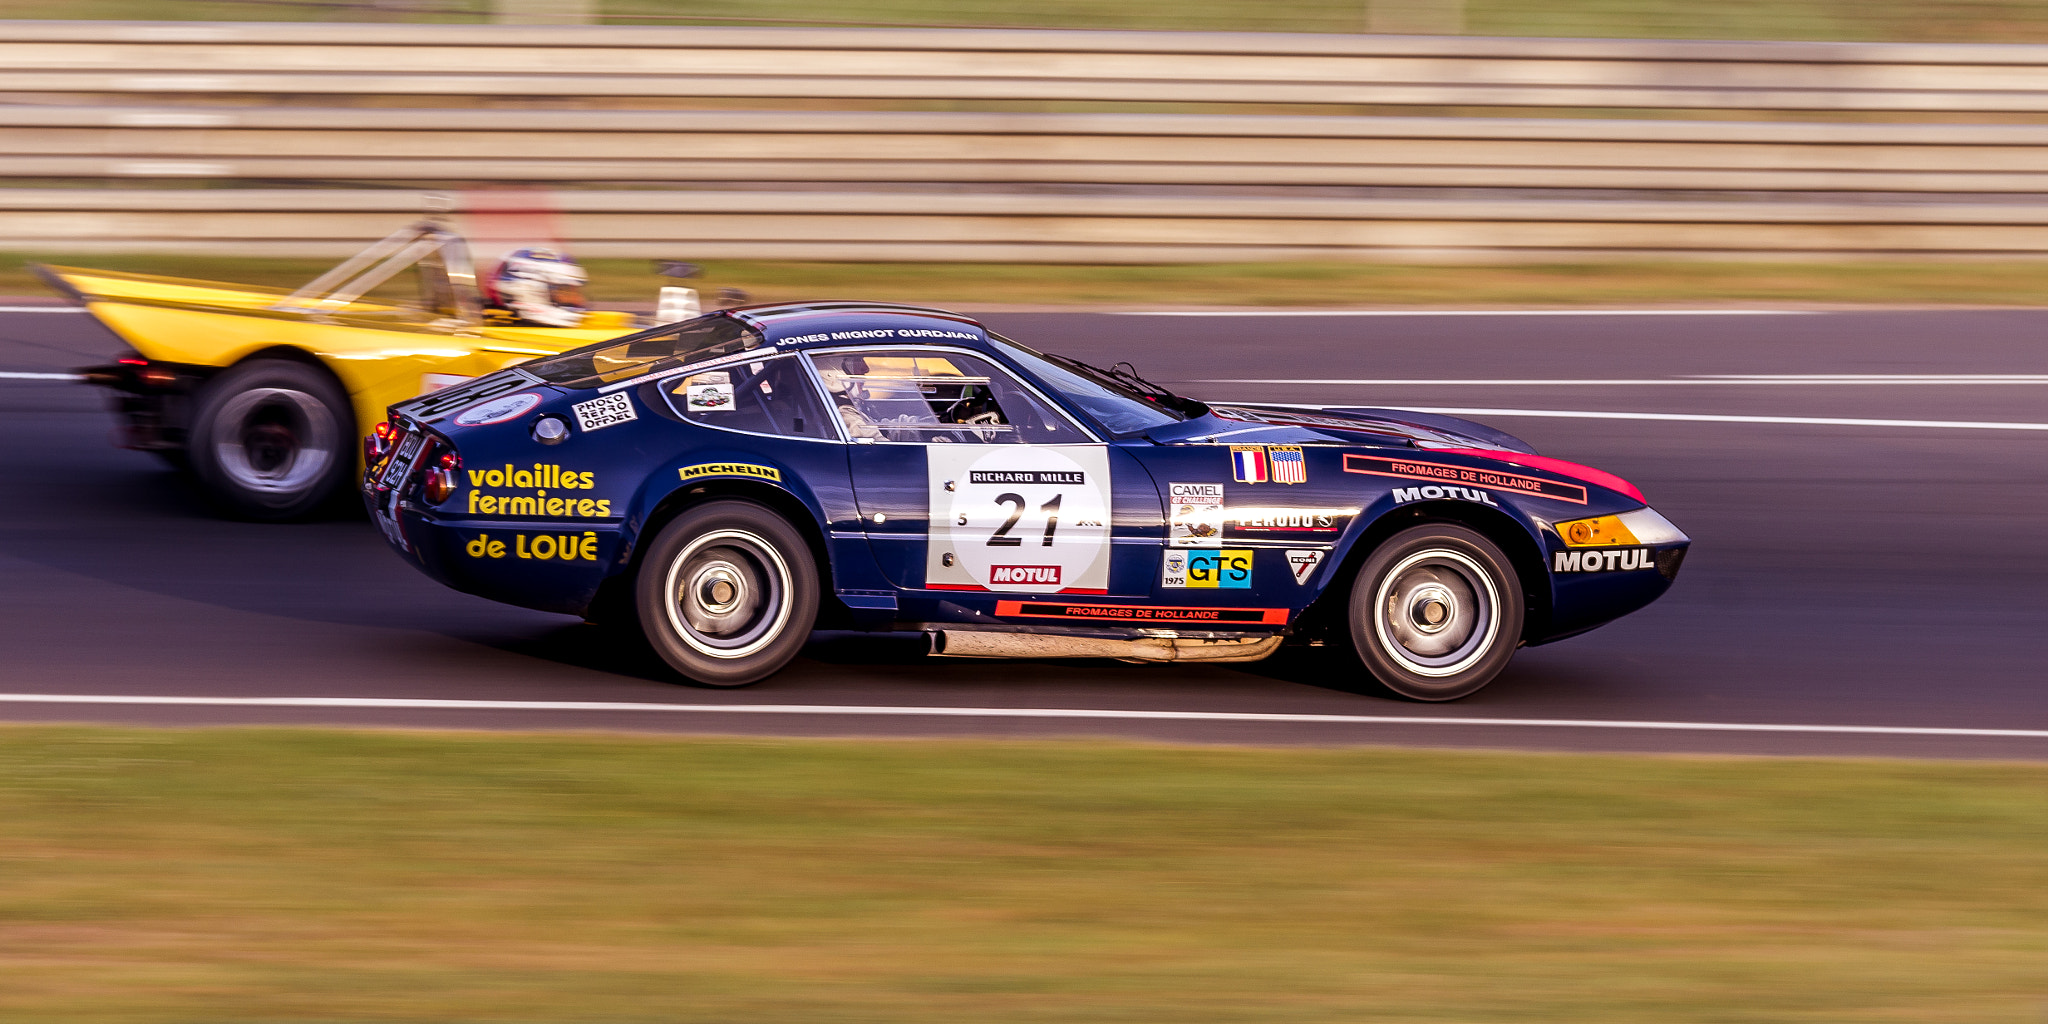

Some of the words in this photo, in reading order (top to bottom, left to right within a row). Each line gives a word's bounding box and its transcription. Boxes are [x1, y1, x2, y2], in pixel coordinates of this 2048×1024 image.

[776, 332, 830, 347] JONES
[831, 329, 895, 341] MIGNOT
[897, 329, 979, 341] GURDJIAN
[576, 394, 623, 412] PHOTO
[580, 402, 627, 419] REPRO
[585, 410, 632, 428] OFFSET
[467, 463, 595, 490] volailles
[684, 465, 776, 478] MICHELIN
[972, 472, 1034, 482] RICHARD
[1040, 473, 1082, 483] MILLE
[1391, 463, 1458, 480] FROMAGES
[1460, 470, 1477, 482] DE
[1479, 473, 1542, 492] HOLLANDE
[1172, 485, 1220, 496] CAMEL
[1391, 485, 1499, 507] MOTUL
[467, 489, 611, 517] fermieres
[1182, 496, 1221, 505] CHALLENGE
[986, 492, 1063, 547] 21
[466, 533, 506, 559] de
[1189, 556, 1248, 582] GTS
[1554, 548, 1655, 573] MOTUL
[993, 567, 1058, 582] MOTUL
[1164, 577, 1184, 585] 1975
[1065, 606, 1133, 617] FROMAGES
[1135, 608, 1153, 618] DE
[1155, 609, 1219, 619] HOLLANDE
